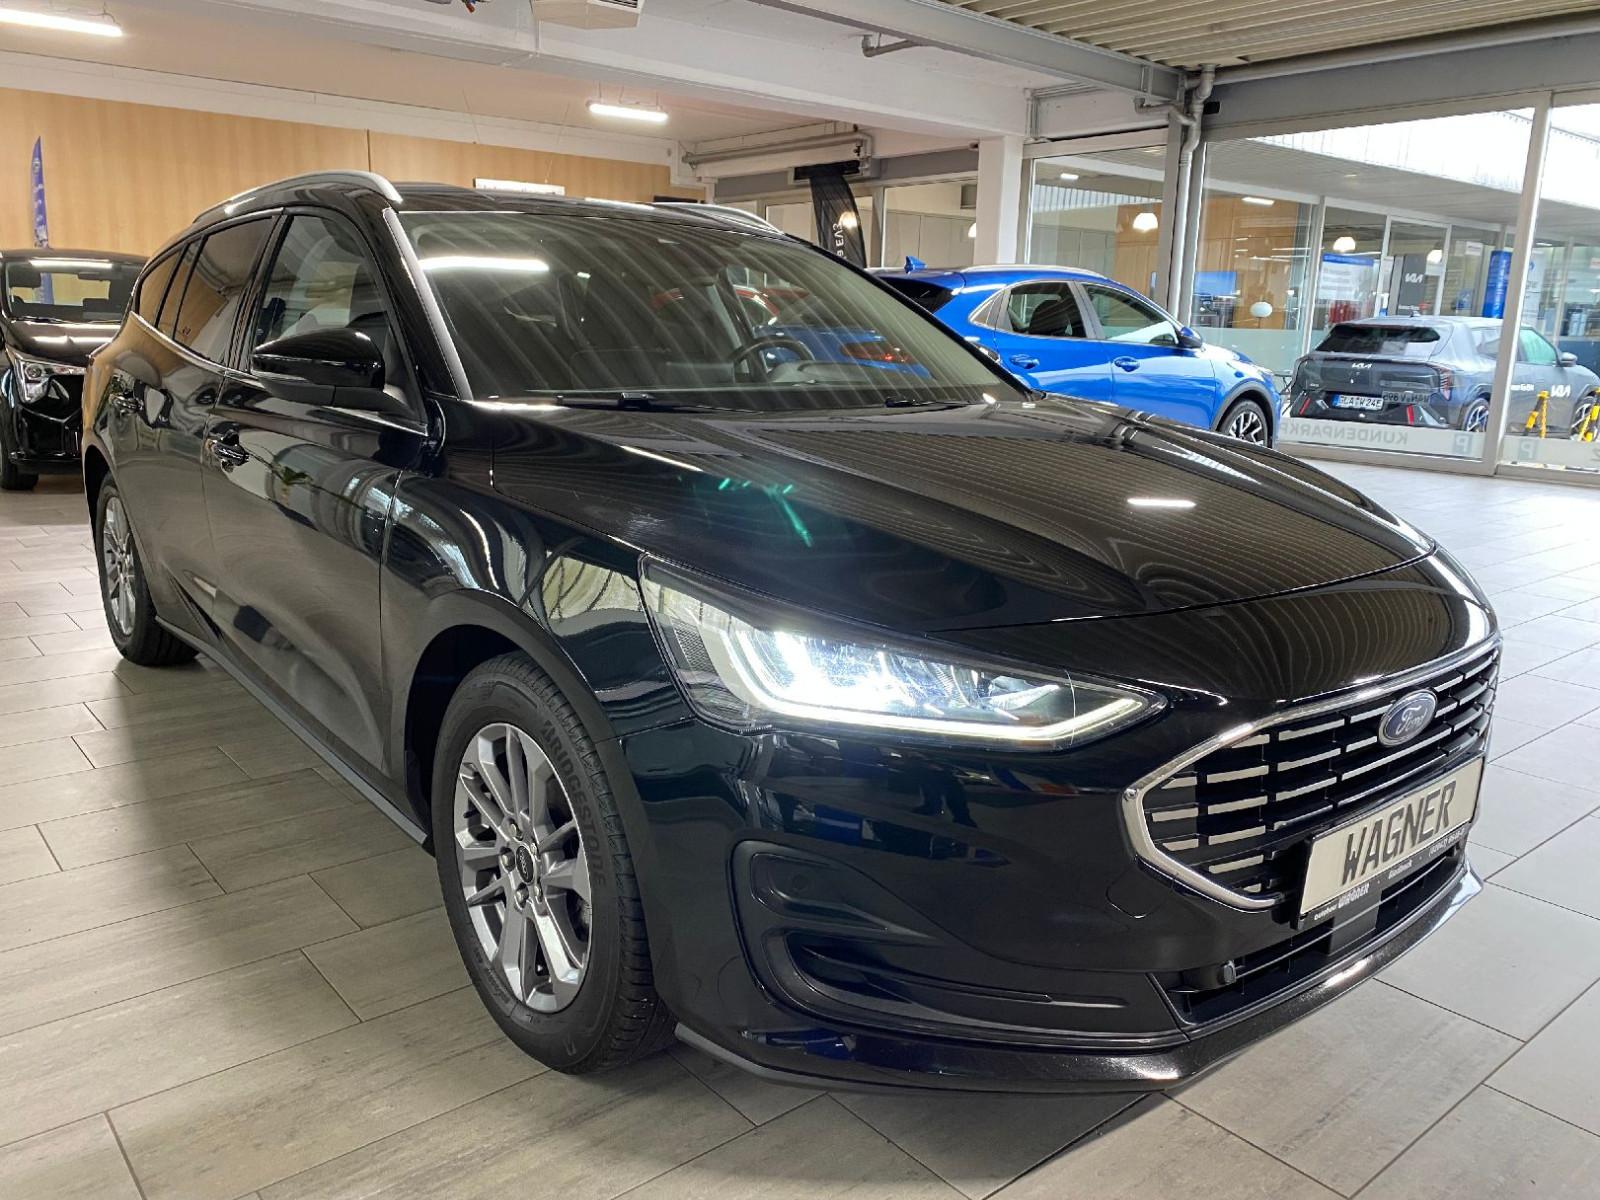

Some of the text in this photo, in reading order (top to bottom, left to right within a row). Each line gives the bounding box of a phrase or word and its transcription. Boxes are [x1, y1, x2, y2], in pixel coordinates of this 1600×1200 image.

[1550, 384, 1571, 397] KIA
[1395, 705, 1428, 735] Ford
[541, 719, 607, 886] BRIDGESTONE
[1341, 780, 1456, 886] WAGNER
